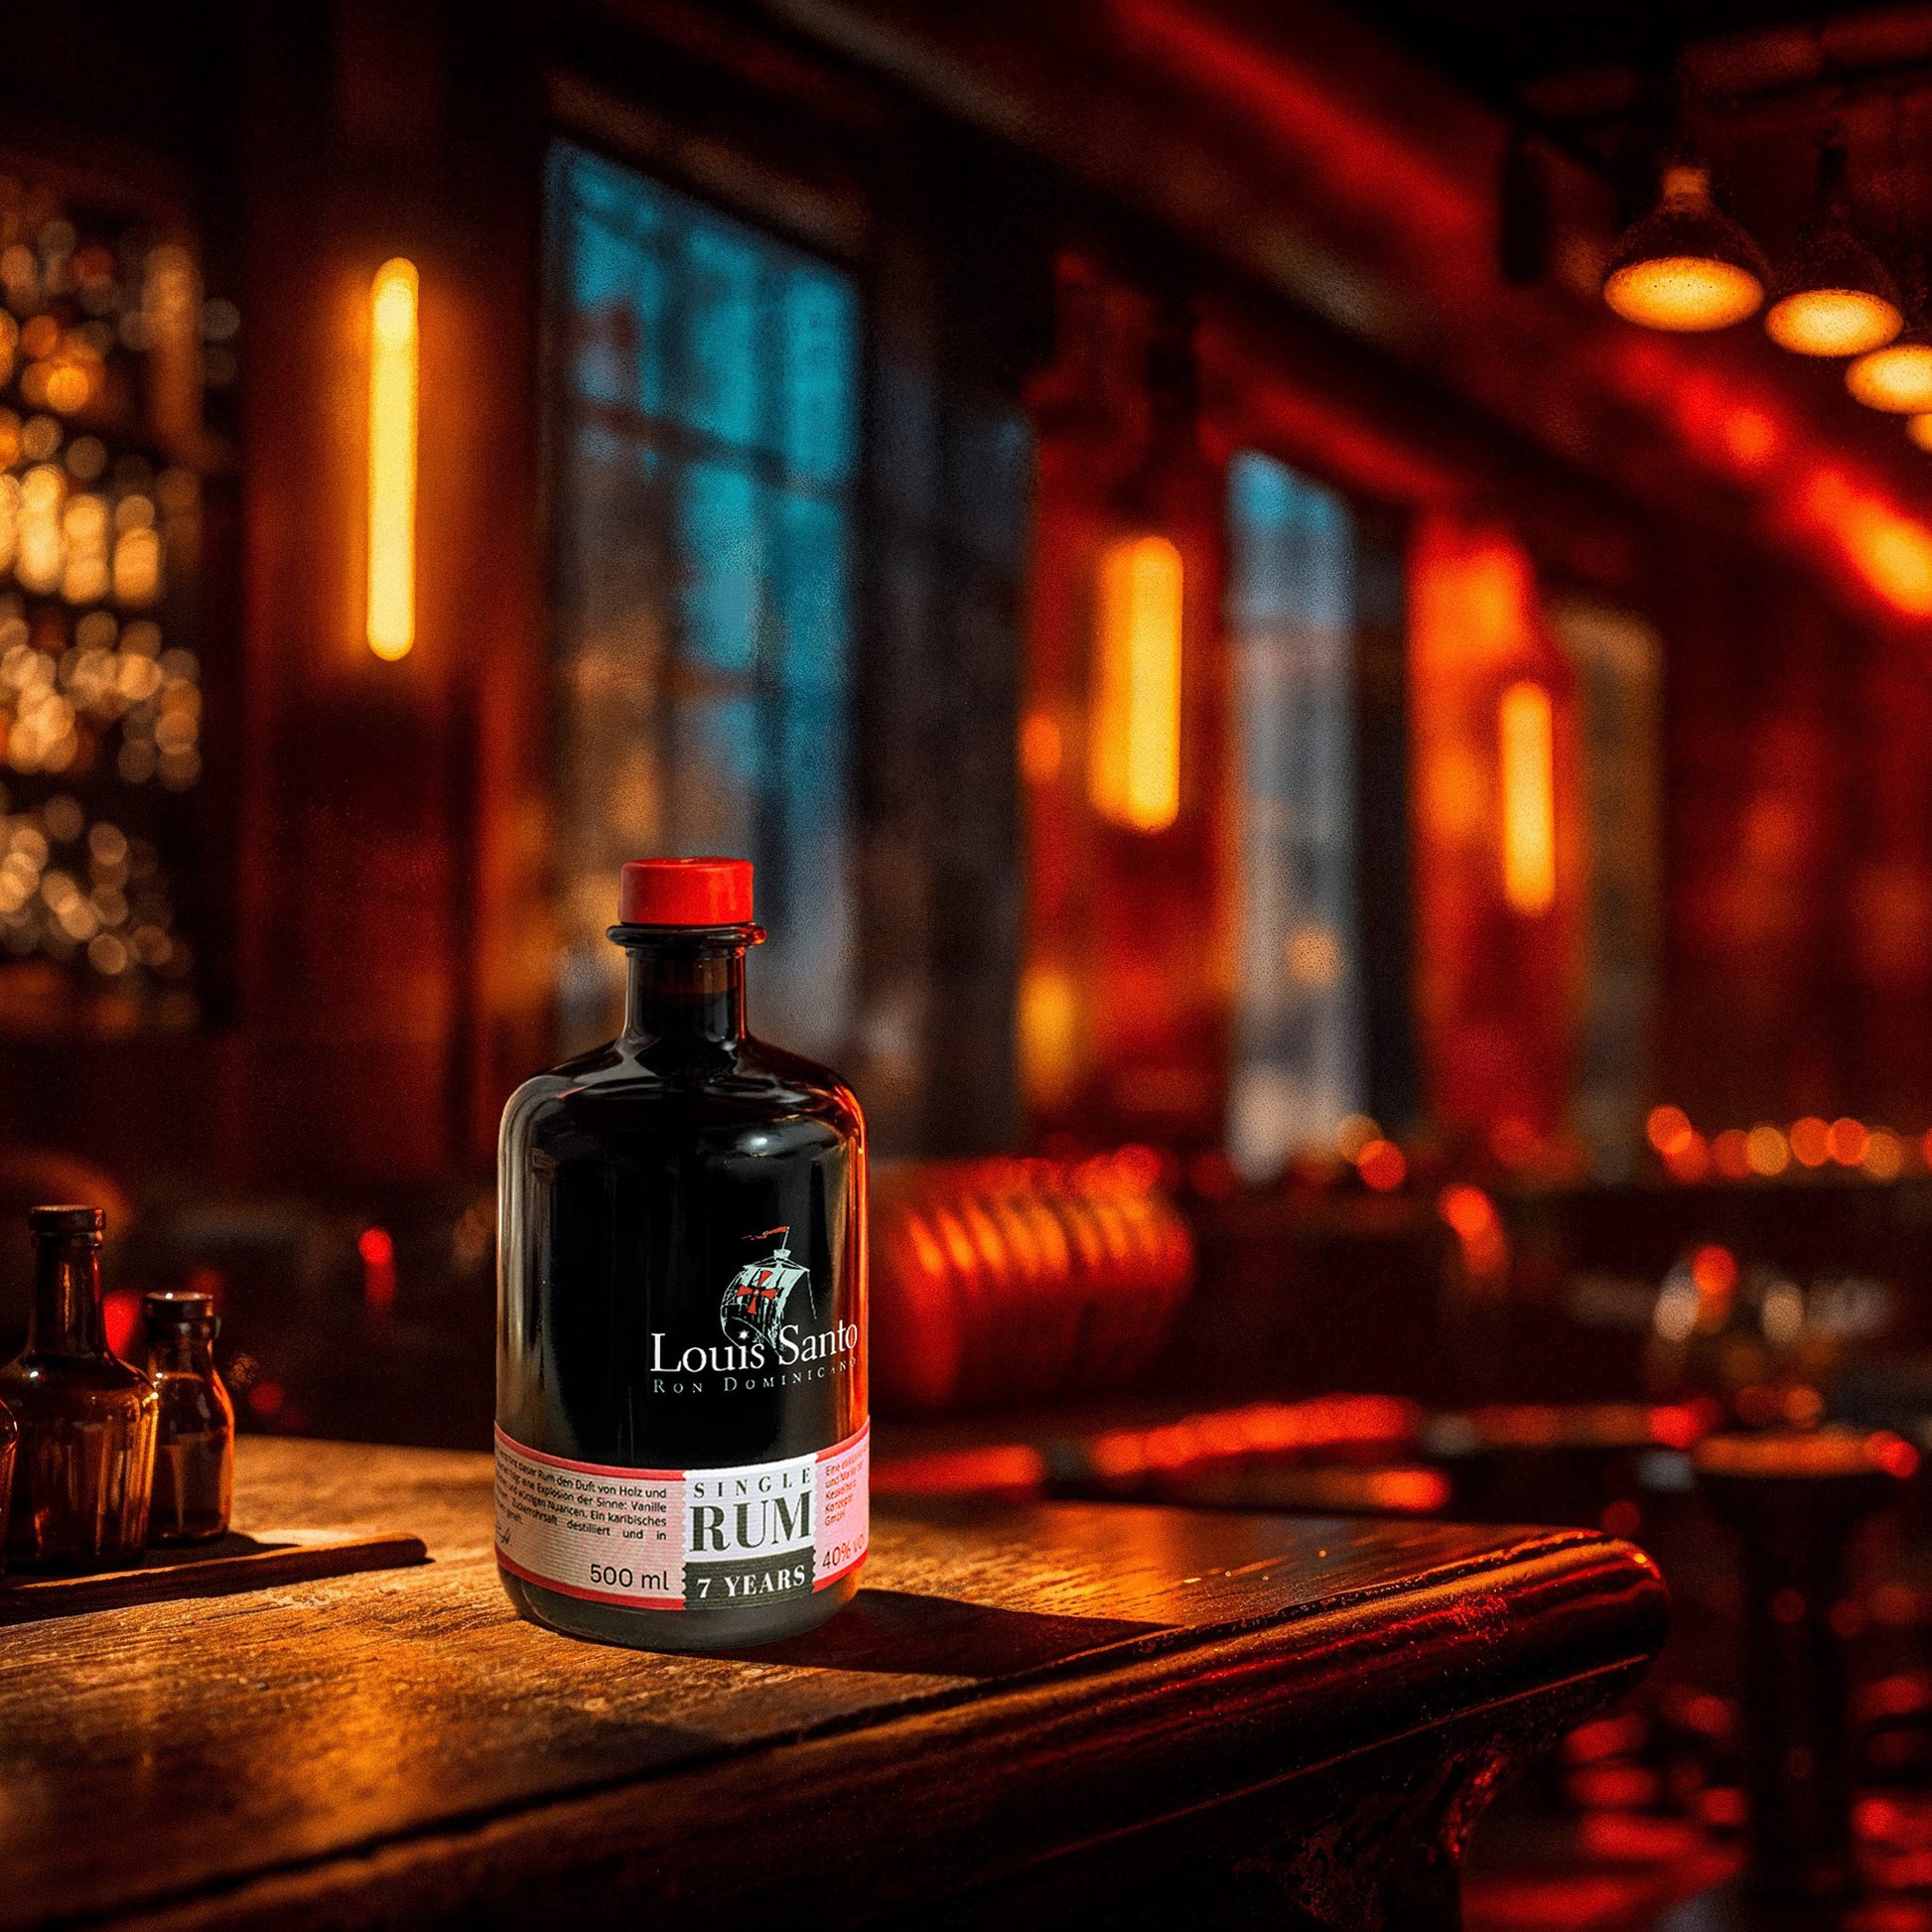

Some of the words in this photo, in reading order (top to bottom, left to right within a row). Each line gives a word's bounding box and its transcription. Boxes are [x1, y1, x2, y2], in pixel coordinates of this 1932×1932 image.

[650, 1332, 764, 1372] Louis
[778, 1319, 858, 1366] Santo
[557, 1475, 573, 1488] den
[576, 1480, 595, 1492] Duft
[598, 1485, 616, 1494] von
[620, 1486, 642, 1497] Holz
[645, 1489, 666, 1498] und
[693, 1467, 812, 1499] SINGLE
[537, 1483, 574, 1501] Explosion
[577, 1494, 593, 1504] der
[597, 1497, 627, 1509] Sinne:
[631, 1501, 666, 1512] Vanille
[548, 1501, 587, 1518] Nuancen.
[591, 1510, 605, 1520] Ein
[608, 1513, 666, 1527] karibisches
[689, 1489, 813, 1552] RUM
[567, 1520, 611, 1536] destilliert
[622, 1530, 643, 1539] und
[657, 1531, 666, 1540] in
[822, 1541, 851, 1569] 40%
[590, 1564, 632, 1587] 500
[641, 1571, 669, 1590] ml
[697, 1579, 711, 1598] 7
[723, 1565, 806, 1596] YEARS
